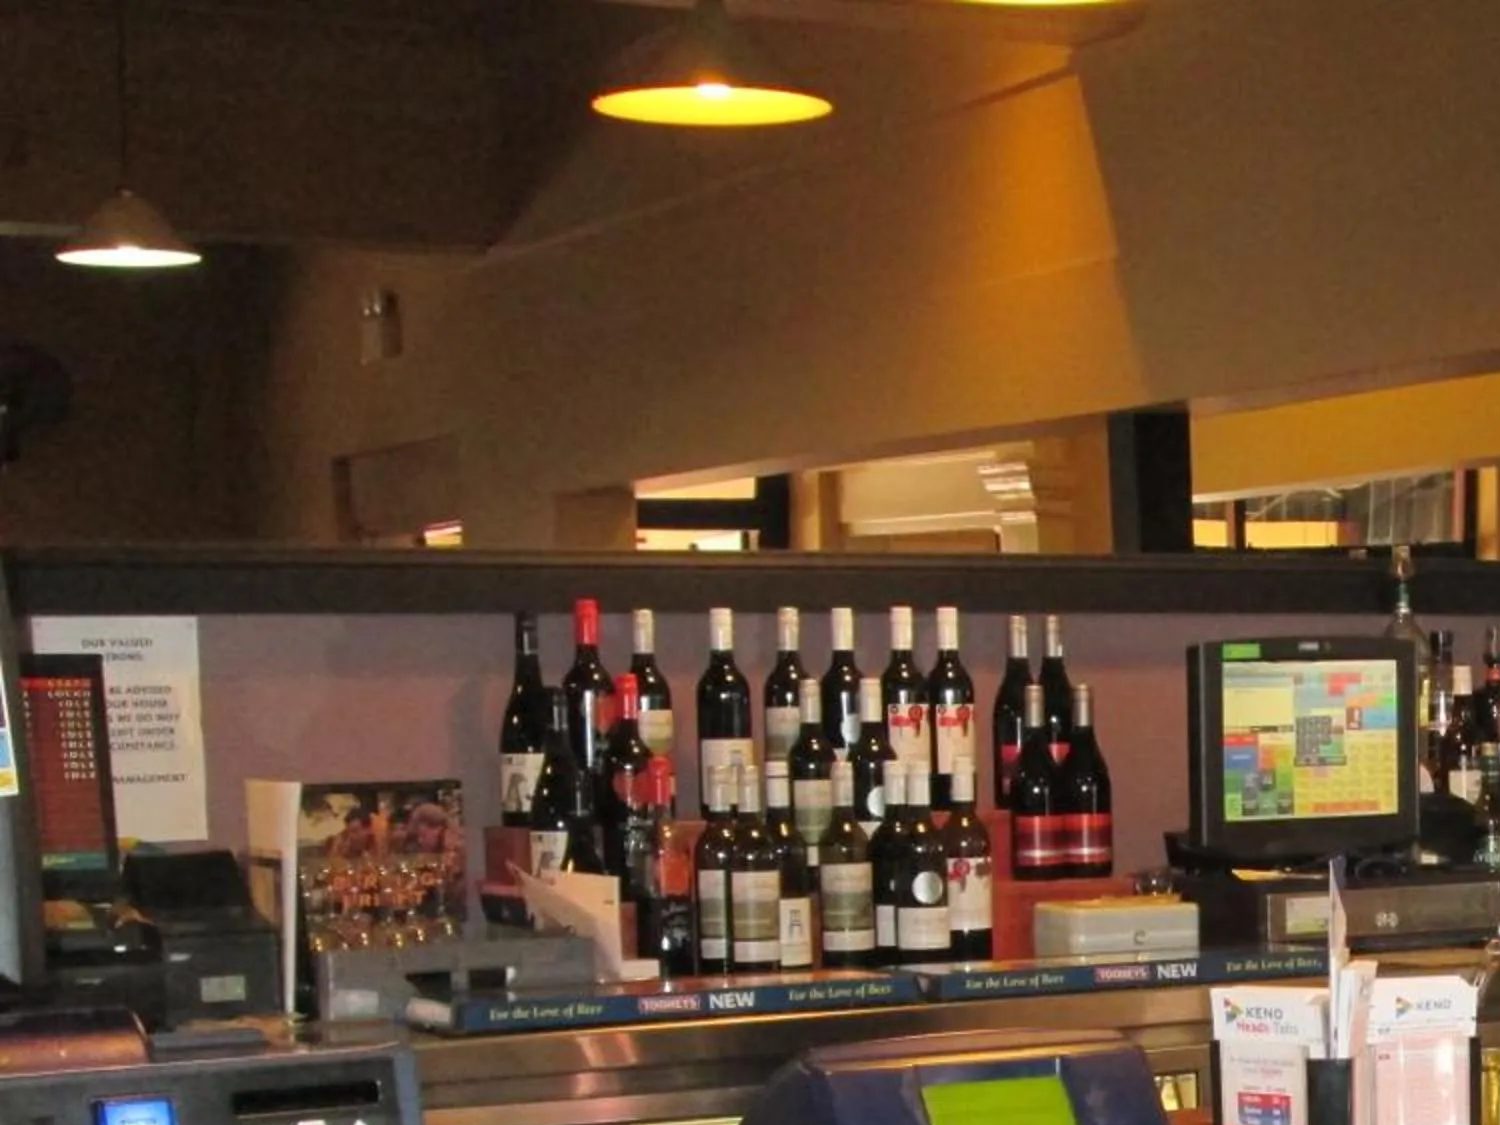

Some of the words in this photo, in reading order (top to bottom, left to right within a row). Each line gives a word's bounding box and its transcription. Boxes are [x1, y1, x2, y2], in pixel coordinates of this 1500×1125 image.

[1156, 962, 1198, 980] NEW
[708, 992, 756, 1010] NEW
[1245, 1006, 1284, 1020] KENO
